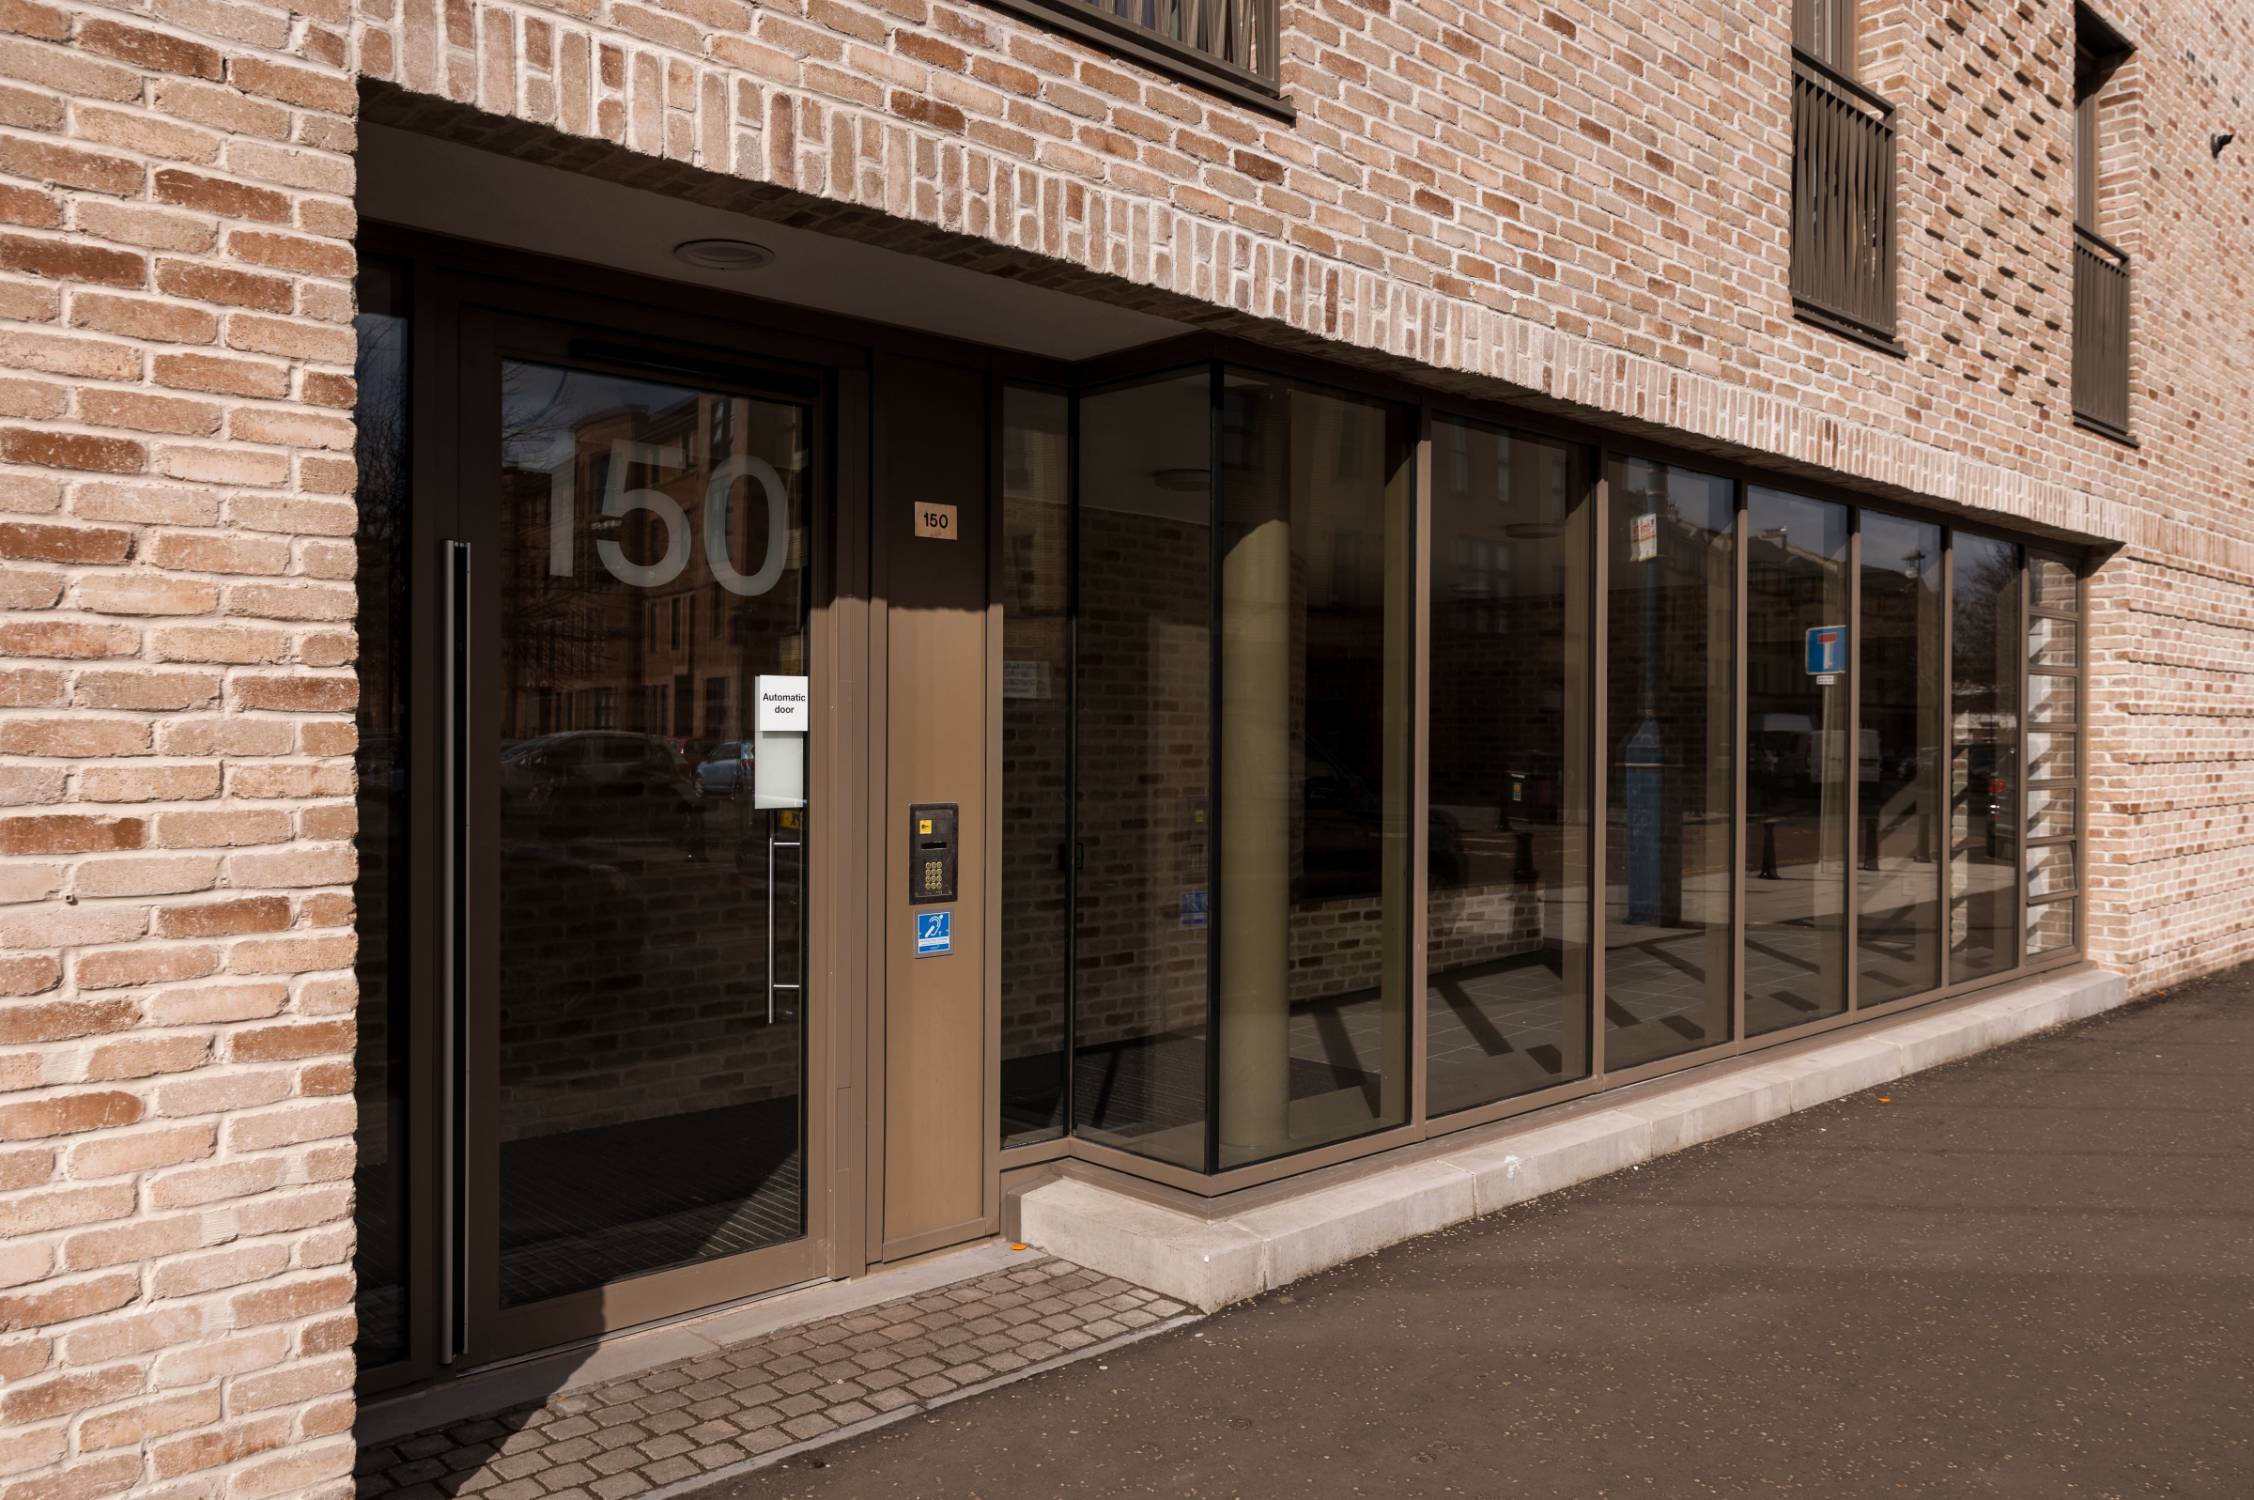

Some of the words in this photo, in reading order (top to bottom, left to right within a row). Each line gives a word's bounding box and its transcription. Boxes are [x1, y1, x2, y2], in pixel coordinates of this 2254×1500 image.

[518, 426, 790, 597] 150
[924, 512, 948, 528] 150
[763, 693, 806, 702] Automatic
[775, 706, 795, 714] door
